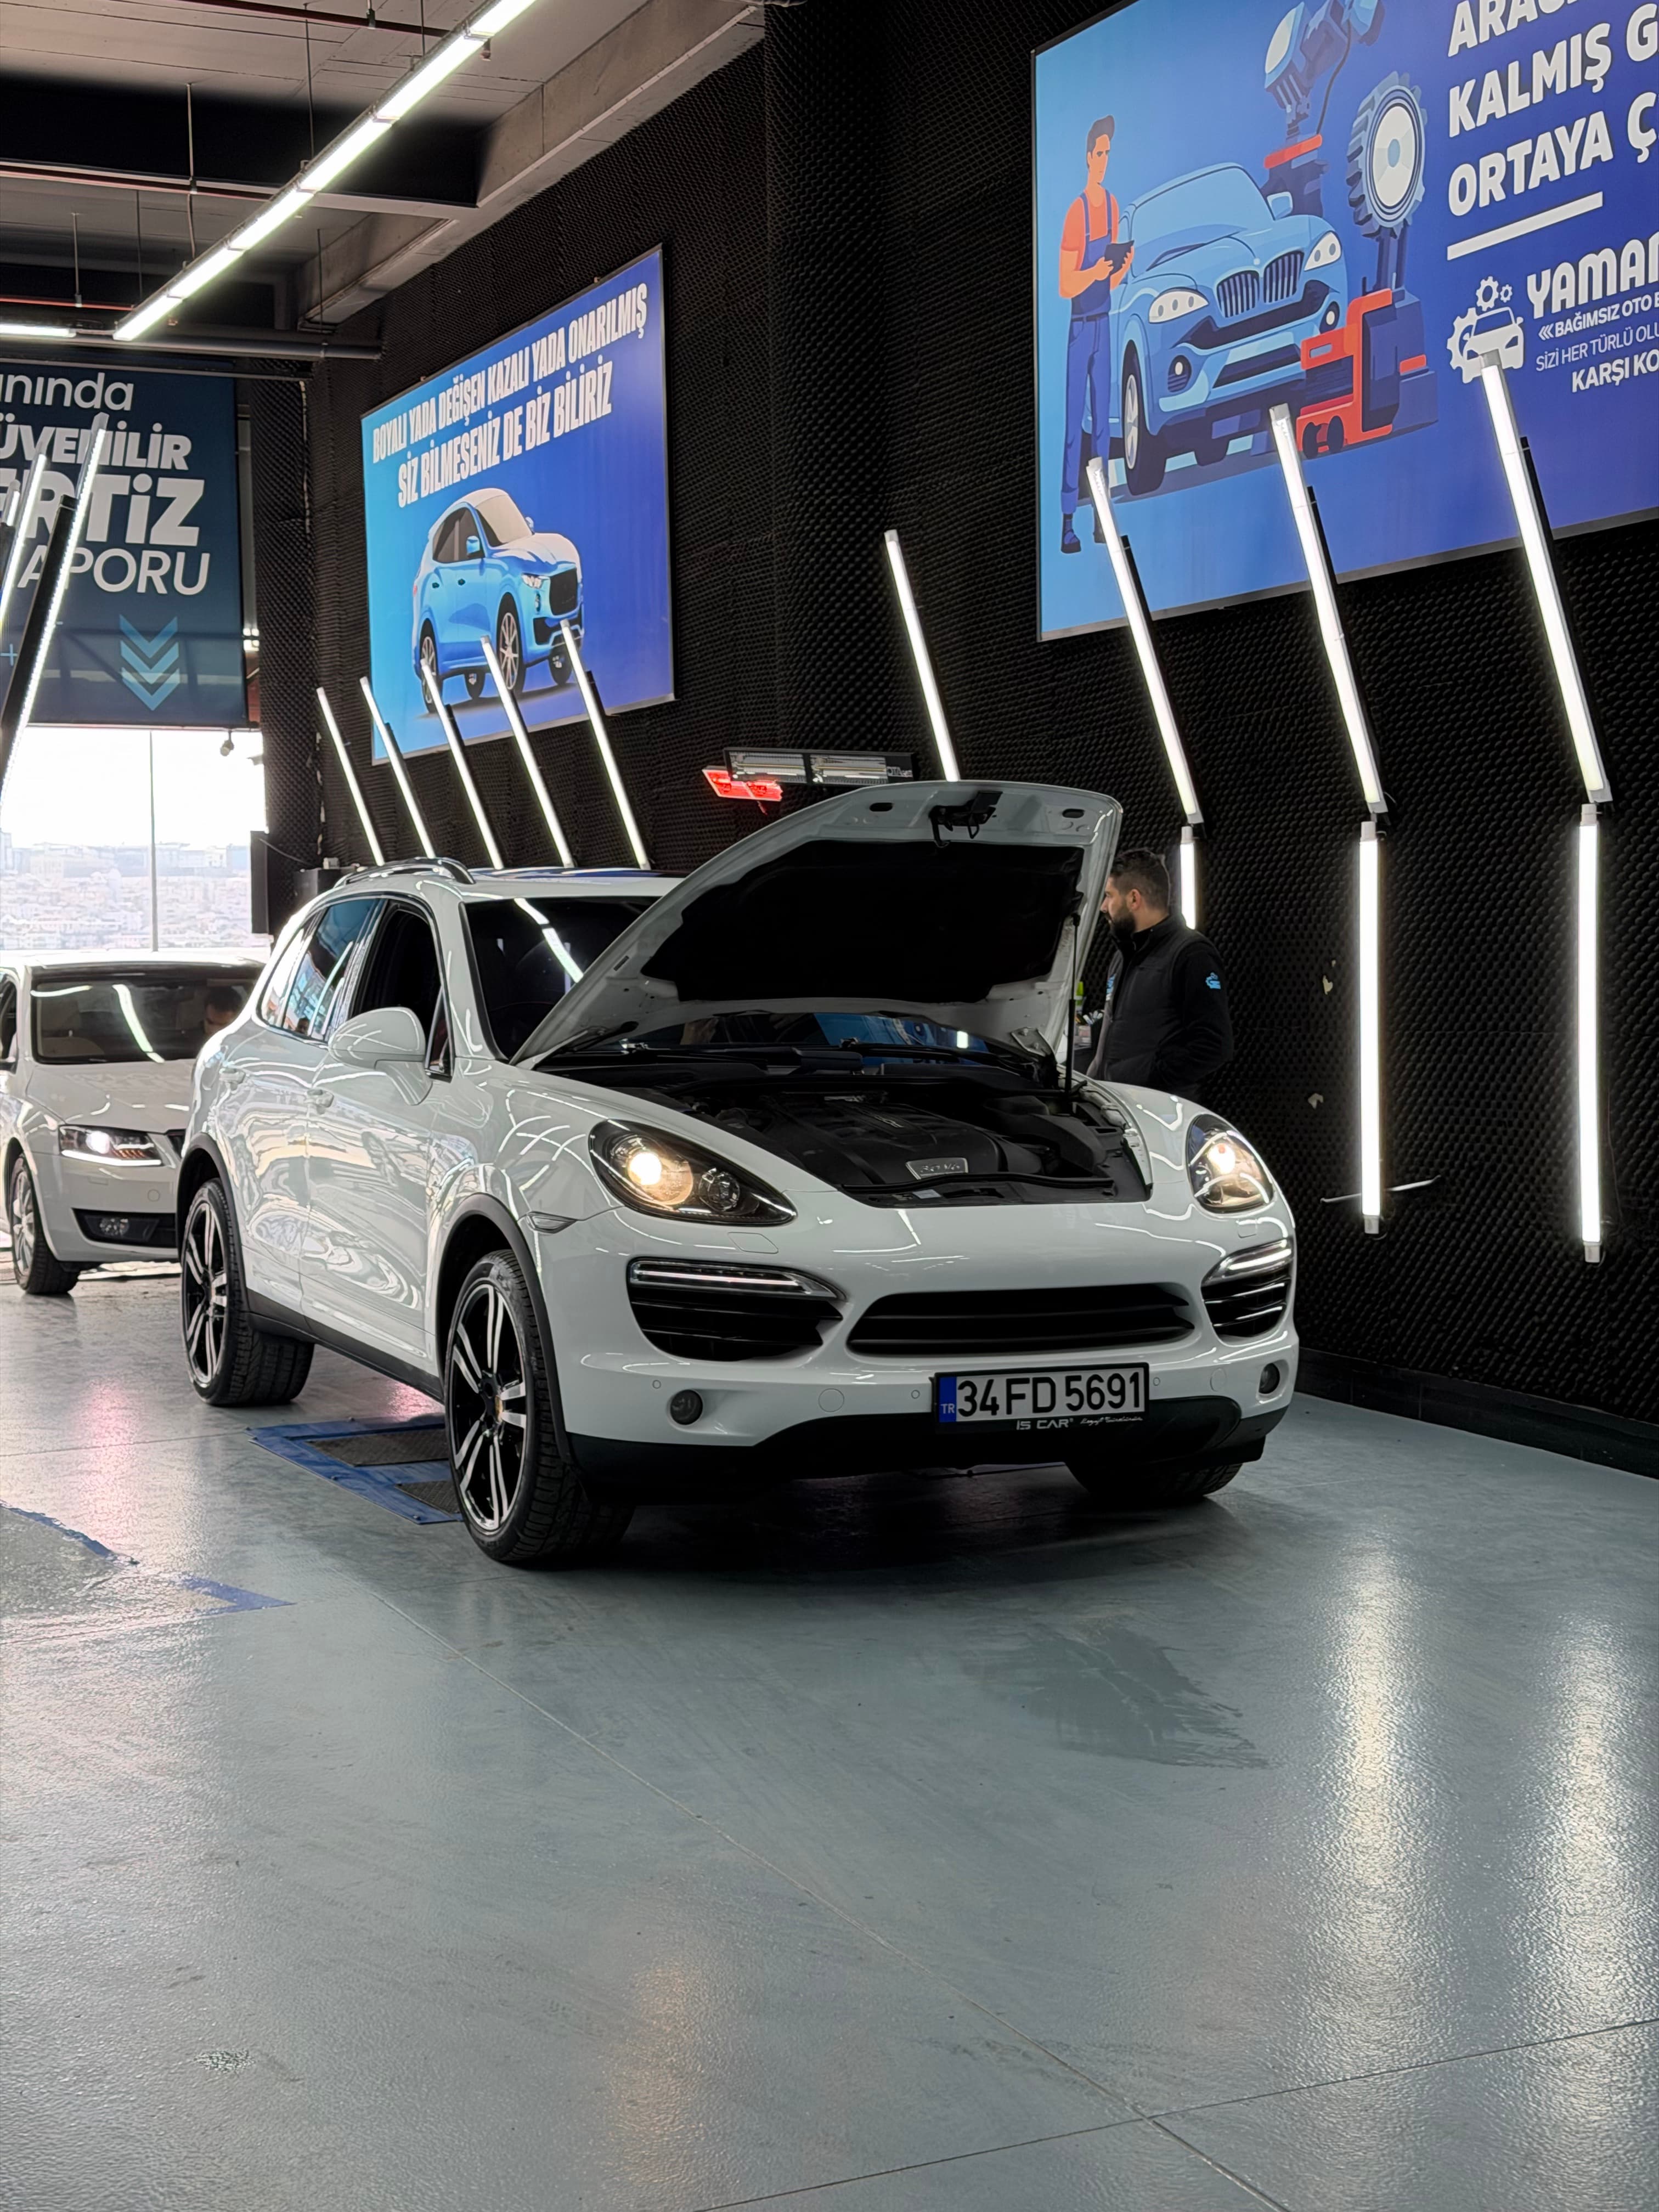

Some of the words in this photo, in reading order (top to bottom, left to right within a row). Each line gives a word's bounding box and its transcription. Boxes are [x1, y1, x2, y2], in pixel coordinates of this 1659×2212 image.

[1448, 0, 1578, 57] ARA
[1449, 22, 1612, 138] KALMIŞ
[1448, 110, 1613, 217] ORTAYA
[1555, 303, 1620, 338] BAĞIMSIZ
[1622, 294, 1652, 317] OTO
[373, 413, 407, 464] BOYALI
[409, 397, 437, 445] YADA
[438, 370, 486, 429] DEĞİŞEN
[487, 346, 529, 405] KAZALI
[532, 326, 566, 382] YADA
[568, 283, 647, 364] ONARILMIŞ
[1536, 347, 1560, 372] SİZİ
[1561, 342, 1588, 365] HER
[1589, 326, 1633, 356] TÜRLÜ
[1572, 357, 1630, 393] KARŞI
[1633, 348, 1659, 376] KO
[0, 372, 134, 411] nında
[398, 450, 419, 508] SİZ
[420, 411, 501, 499] BİLMESENİZ
[503, 405, 523, 461] DE
[526, 385, 551, 452] BİZ
[553, 354, 613, 439] BİLİRİZ
[940, 1403, 955, 1414] TR
[957, 1379, 1000, 1417] 34
[1006, 1376, 1056, 1415] FD
[1065, 1371, 1140, 1412] 5691
